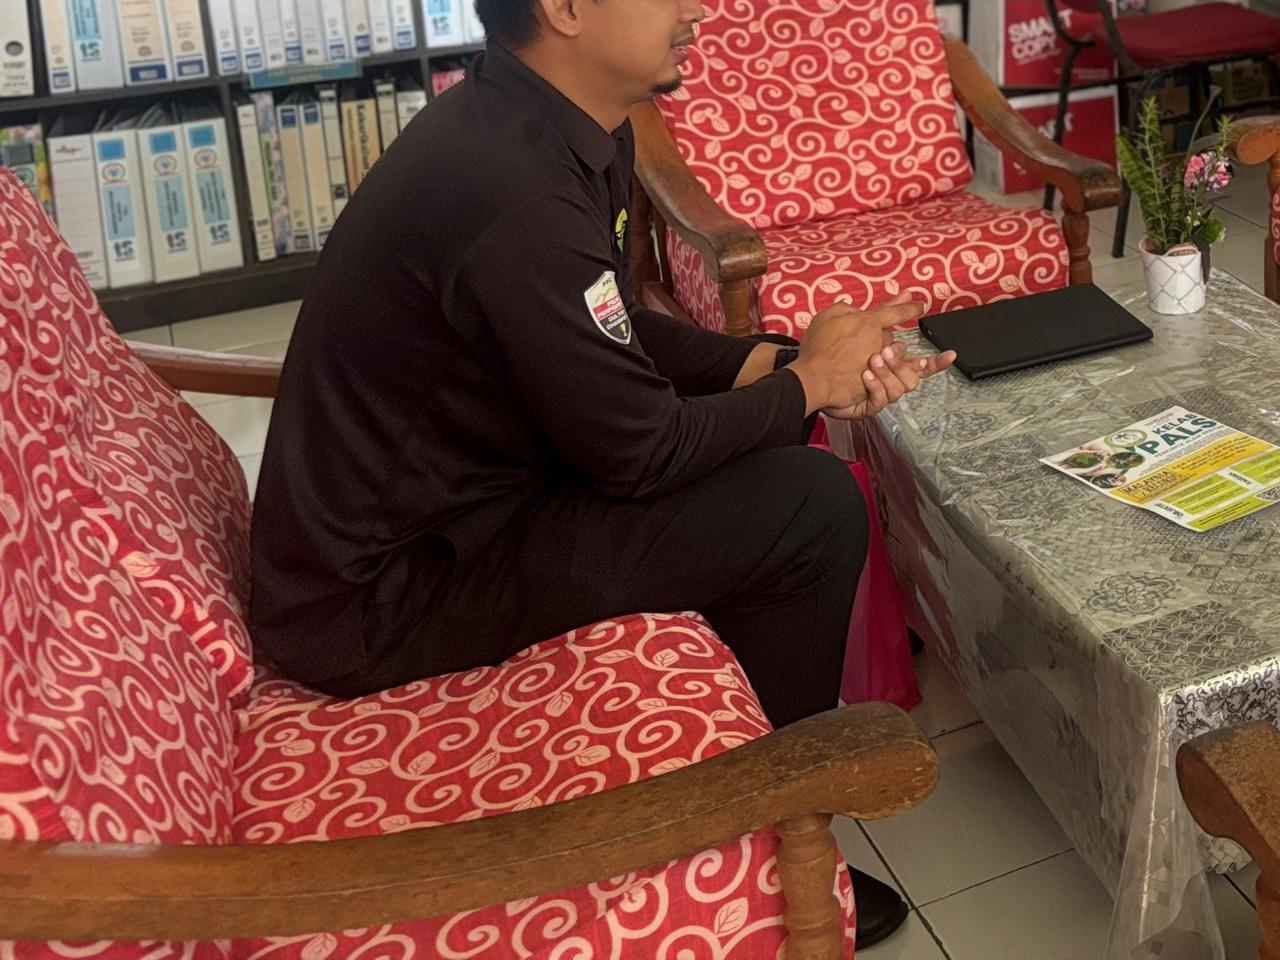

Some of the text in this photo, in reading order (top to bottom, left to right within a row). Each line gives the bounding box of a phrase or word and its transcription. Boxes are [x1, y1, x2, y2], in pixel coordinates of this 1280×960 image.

[1008, 9, 1073, 44] SMAT
[1012, 36, 1057, 61] COPY
[1140, 418, 1217, 455] PALS
[1152, 413, 1198, 435] KELAB
